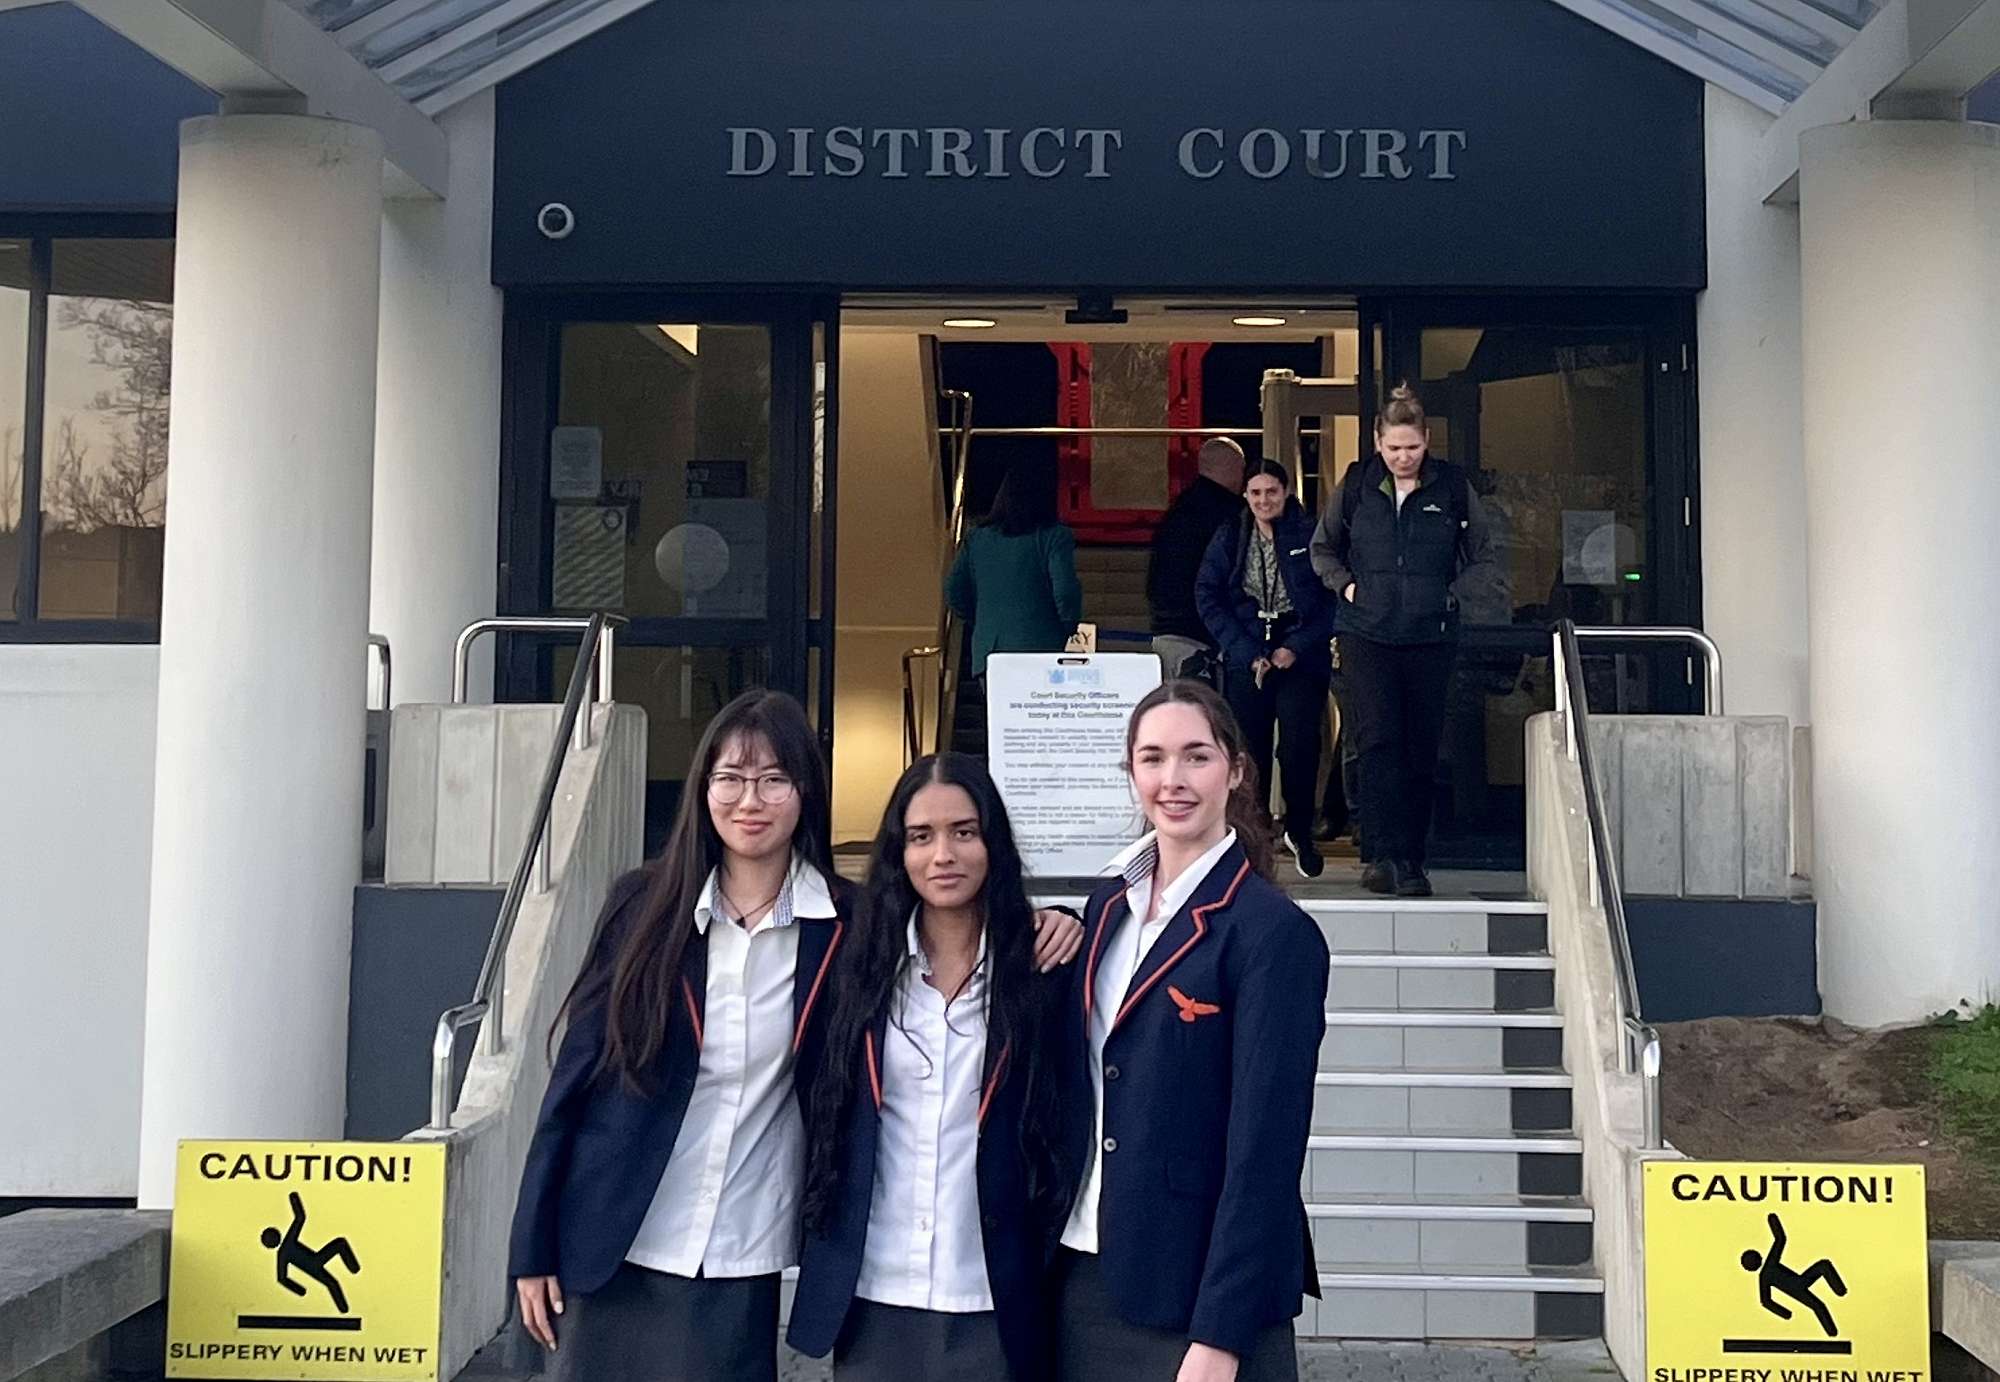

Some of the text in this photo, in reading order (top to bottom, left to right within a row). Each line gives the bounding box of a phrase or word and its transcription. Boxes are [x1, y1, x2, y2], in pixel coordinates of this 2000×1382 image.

[726, 127, 1468, 180] DISTRICT COURT
[200, 1153, 411, 1183] CAUTION!
[1671, 1173, 1893, 1203] CAUTION!
[169, 1343, 427, 1364] SLIPPERY WHEN WET
[1654, 1368, 1923, 1382] SLIPPERY WHEN WET
